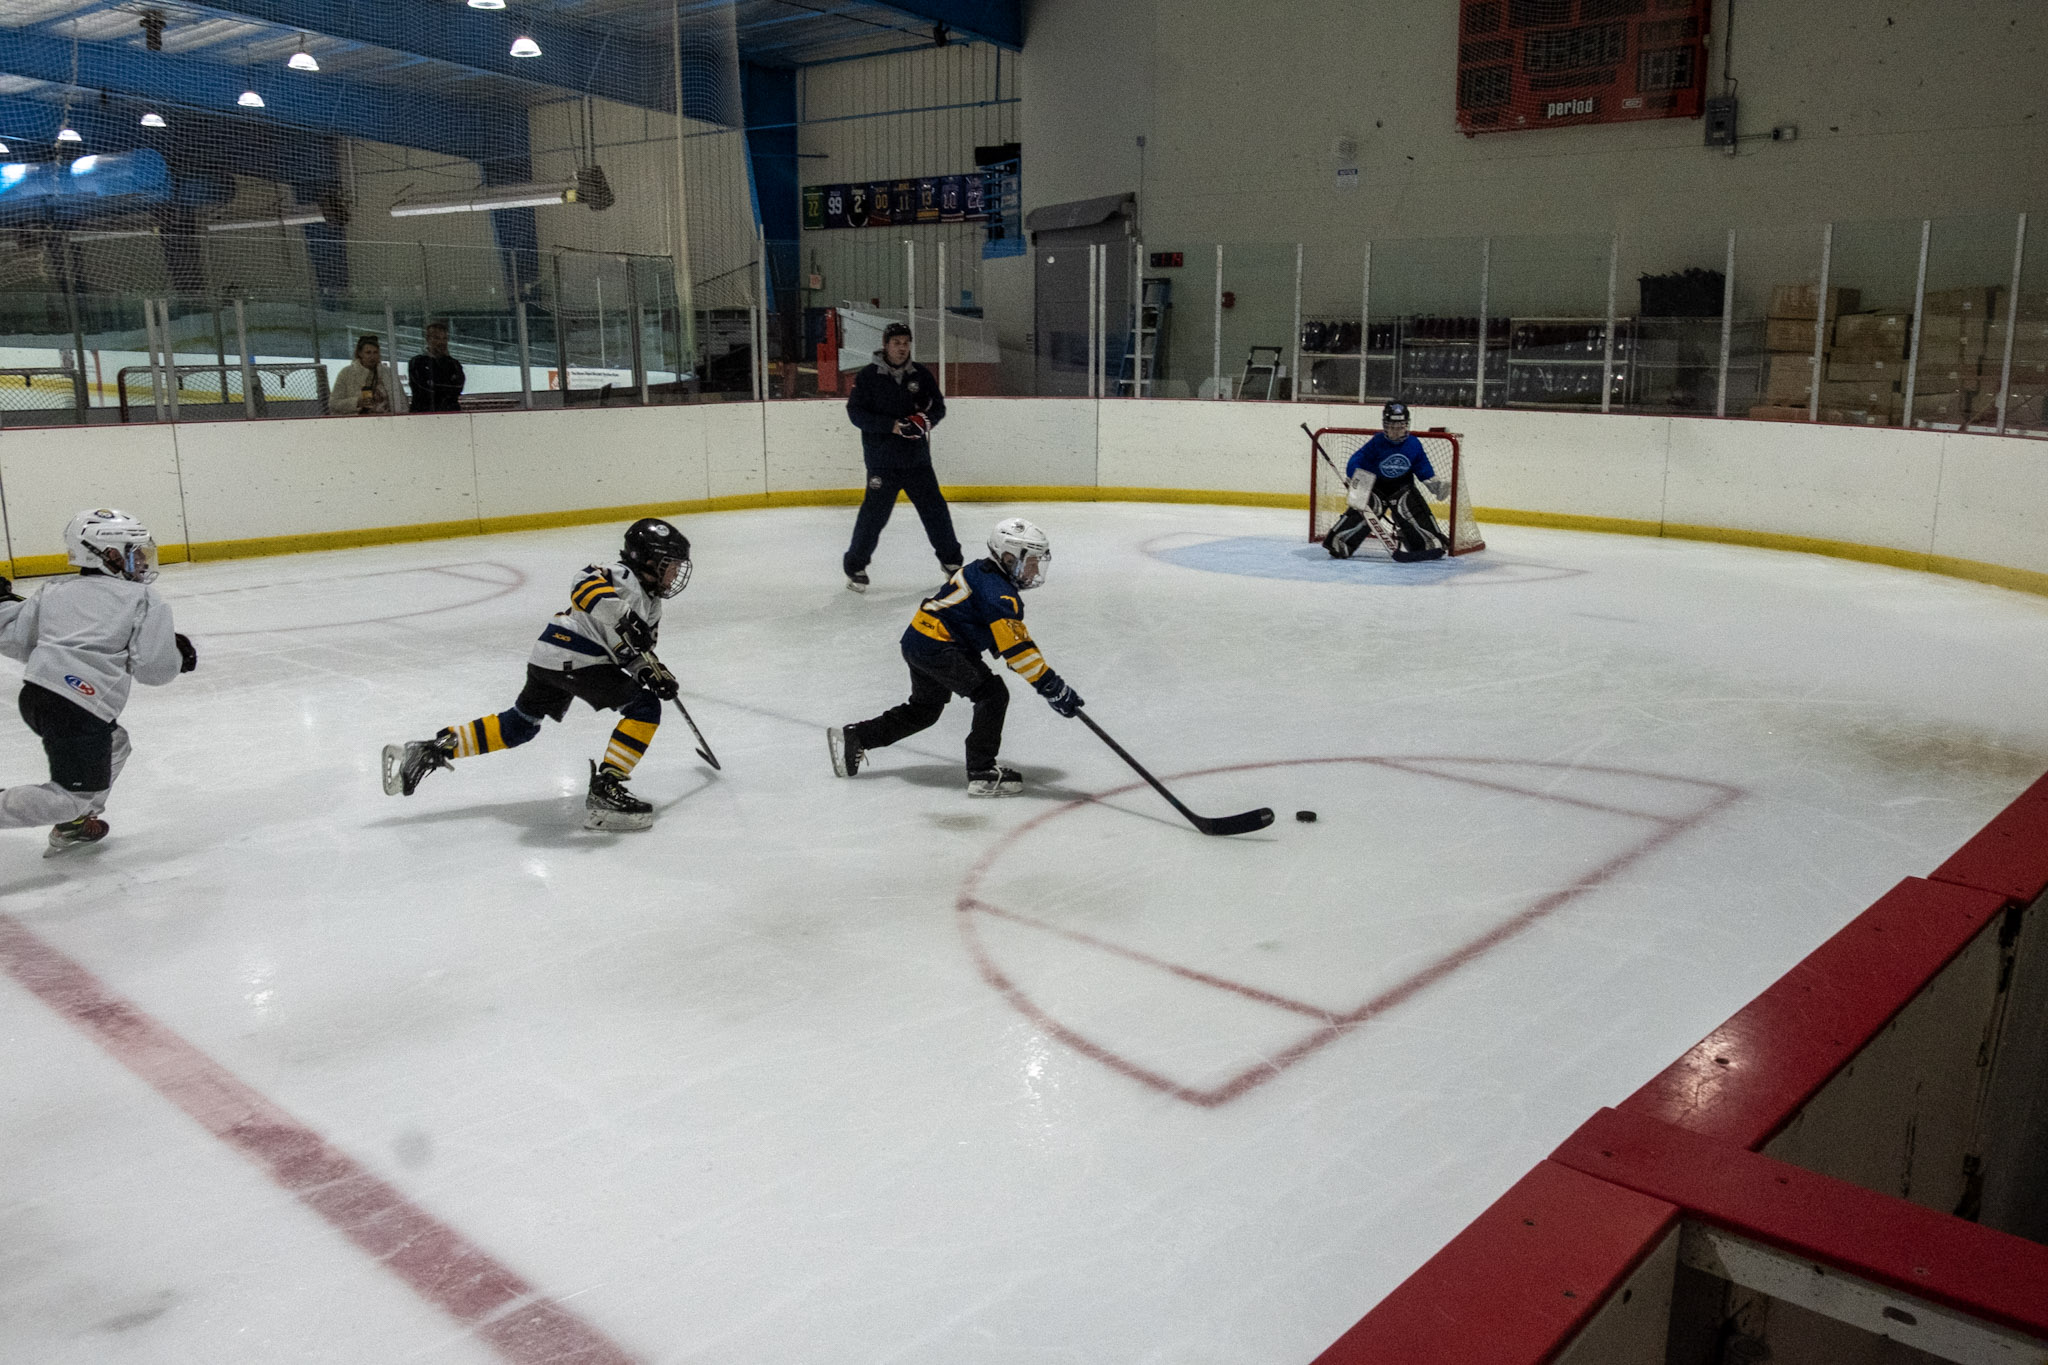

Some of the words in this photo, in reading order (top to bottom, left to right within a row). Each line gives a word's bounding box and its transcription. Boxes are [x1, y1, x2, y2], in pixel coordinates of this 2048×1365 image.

[1547, 97, 1593, 119] period
[827, 196, 843, 215] 99
[853, 195, 863, 214] 2
